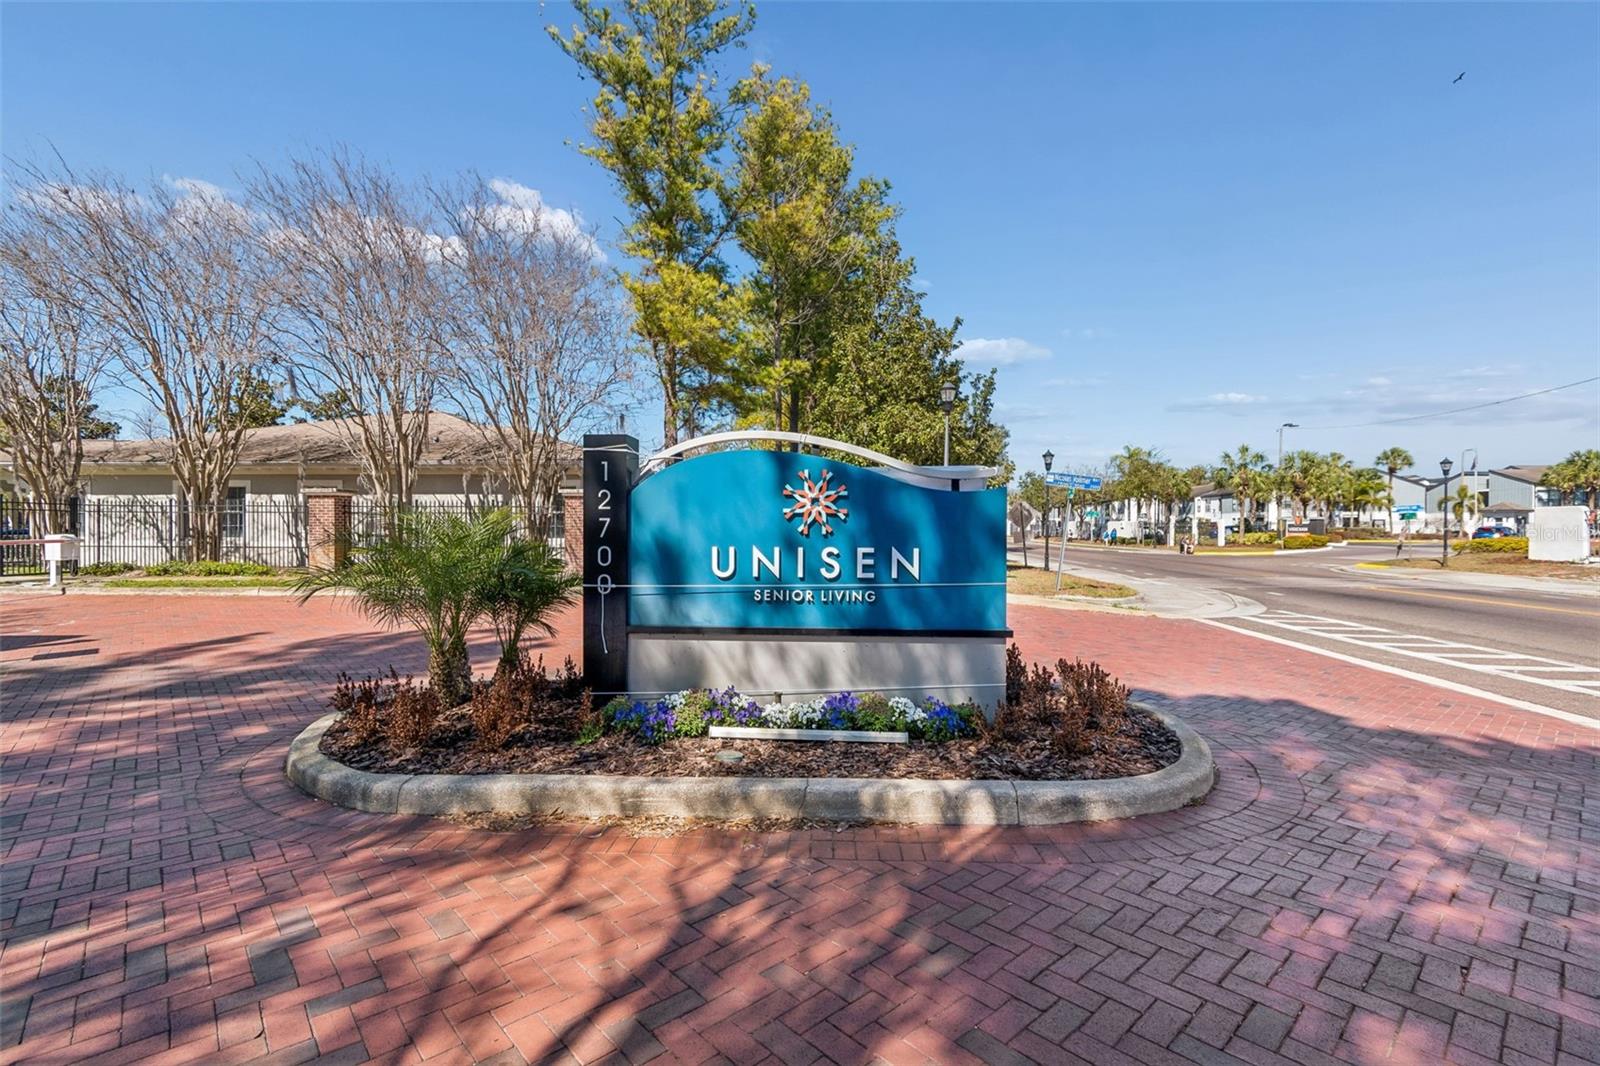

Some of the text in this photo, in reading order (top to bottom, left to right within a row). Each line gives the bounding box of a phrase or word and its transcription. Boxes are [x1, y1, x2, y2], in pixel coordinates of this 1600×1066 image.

[597, 461, 612, 595] 12700
[711, 544, 921, 582] UNISEN
[754, 589, 876, 603] SENIOR LIVING
